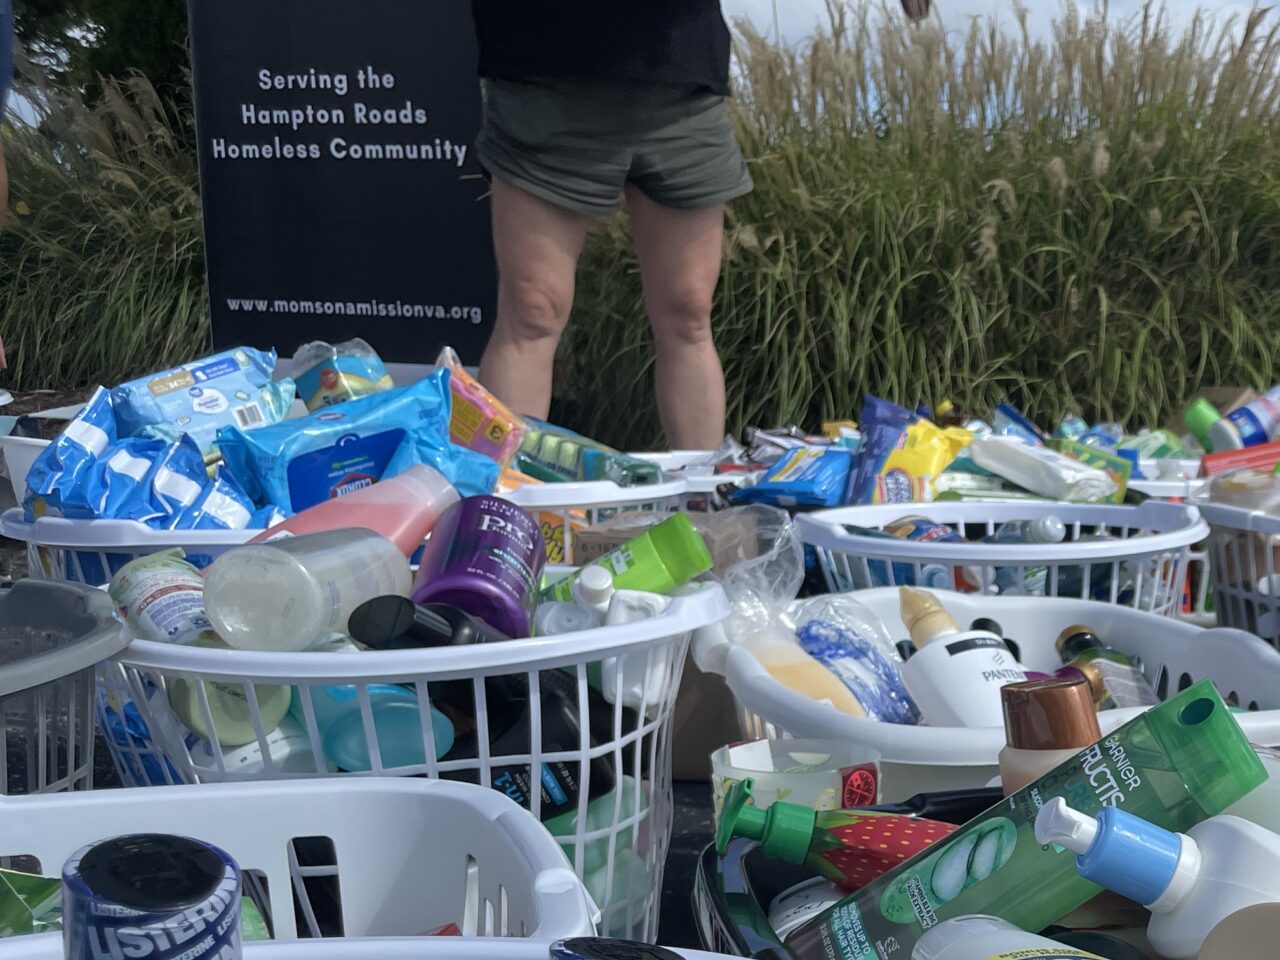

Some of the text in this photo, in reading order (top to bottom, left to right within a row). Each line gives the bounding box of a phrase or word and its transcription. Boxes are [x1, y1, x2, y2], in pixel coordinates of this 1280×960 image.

[258, 66, 395, 95] Serving the
[242, 101, 428, 130] Hampton Roads
[212, 137, 468, 167] Homeless Community
[227, 298, 482, 324] www.momsonamissionva.org
[834, 929, 849, 948] HAIR
[855, 930, 866, 943] UP
[860, 941, 871, 954] TO
